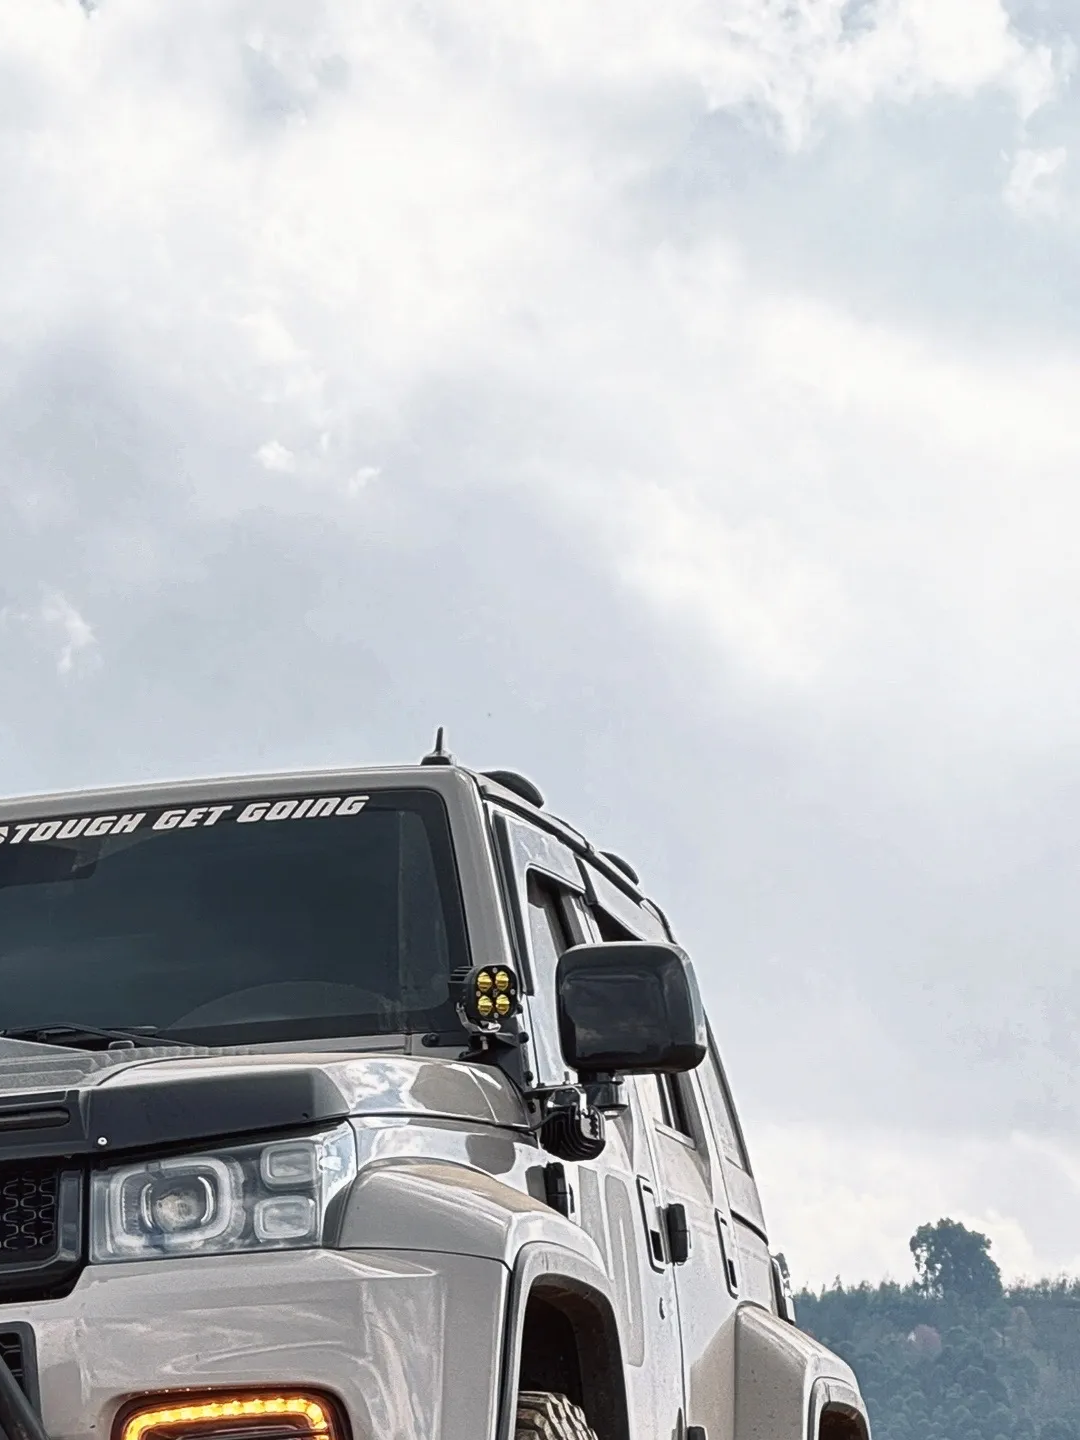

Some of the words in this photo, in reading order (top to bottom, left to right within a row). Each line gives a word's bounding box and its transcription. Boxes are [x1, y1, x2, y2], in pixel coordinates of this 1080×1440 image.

[10, 813, 146, 844] TOUGH
[152, 805, 233, 830] GET
[237, 795, 369, 823] GOING
